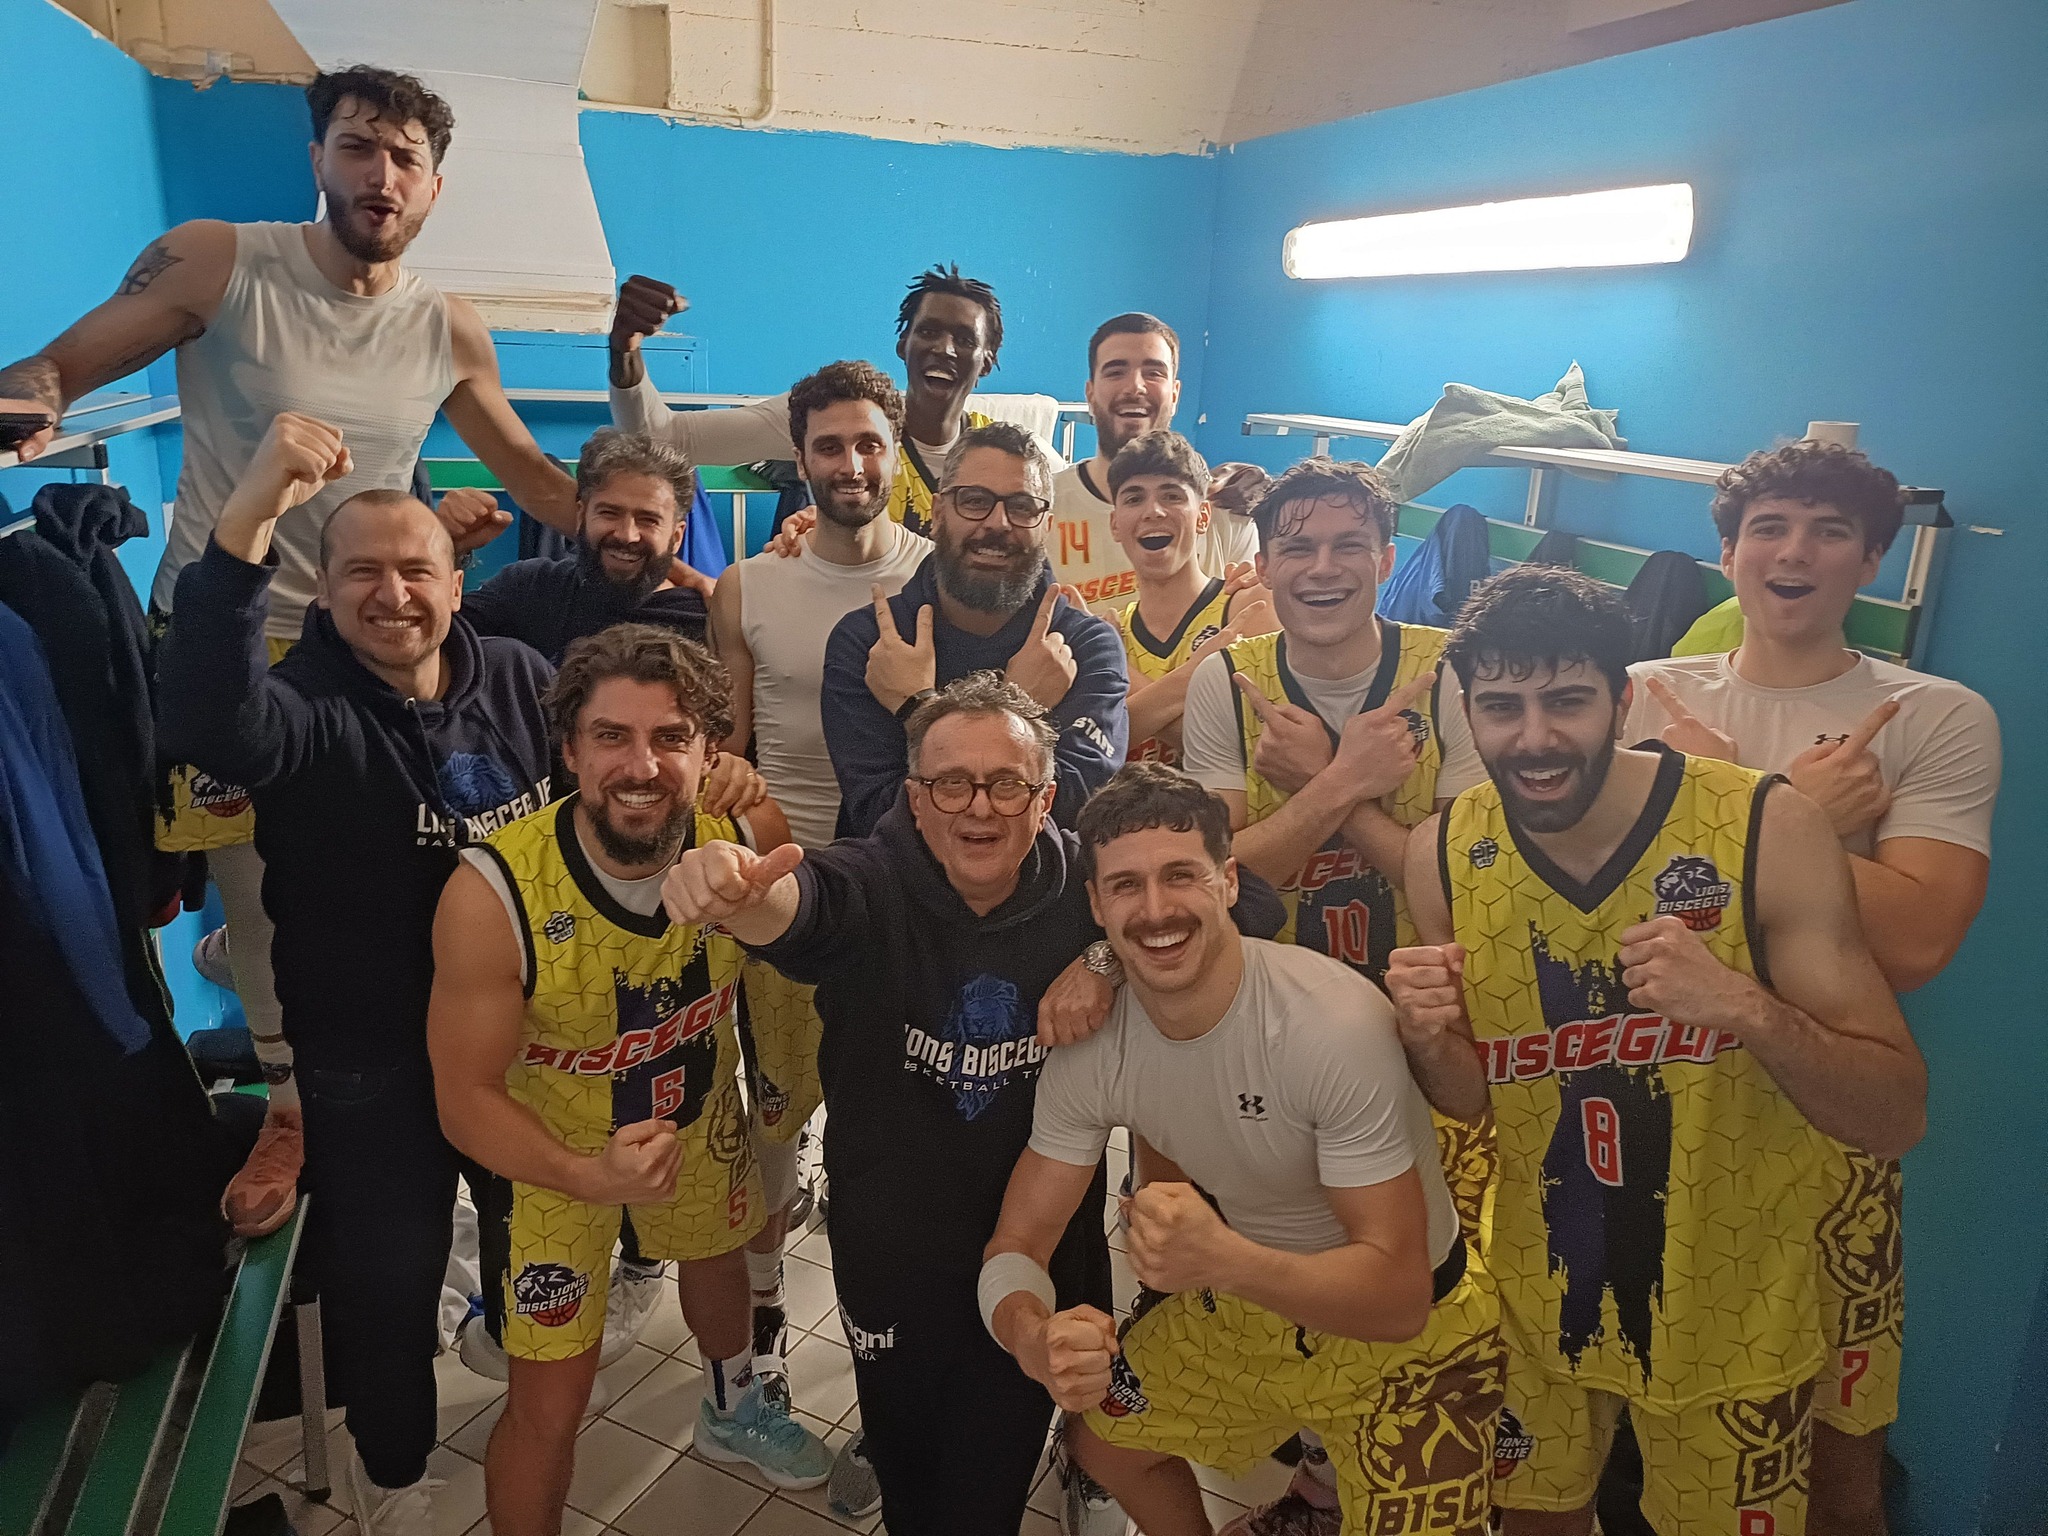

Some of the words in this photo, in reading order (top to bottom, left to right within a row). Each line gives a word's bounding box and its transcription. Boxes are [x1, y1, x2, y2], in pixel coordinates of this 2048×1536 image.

[1057, 520, 1091, 565] 14
[1695, 884, 1728, 897] LIOS
[1322, 899, 1370, 965] 10
[904, 1023, 954, 1073] ONS
[651, 1065, 686, 1120] 5
[1580, 1096, 1624, 1187] 8
[727, 1186, 749, 1230] 5
[517, 1283, 589, 1313] BISCEGLIE
[550, 1275, 587, 1299] LIONS
[1115, 1380, 1147, 1405] LIONS
[1840, 1349, 1869, 1408] 7
